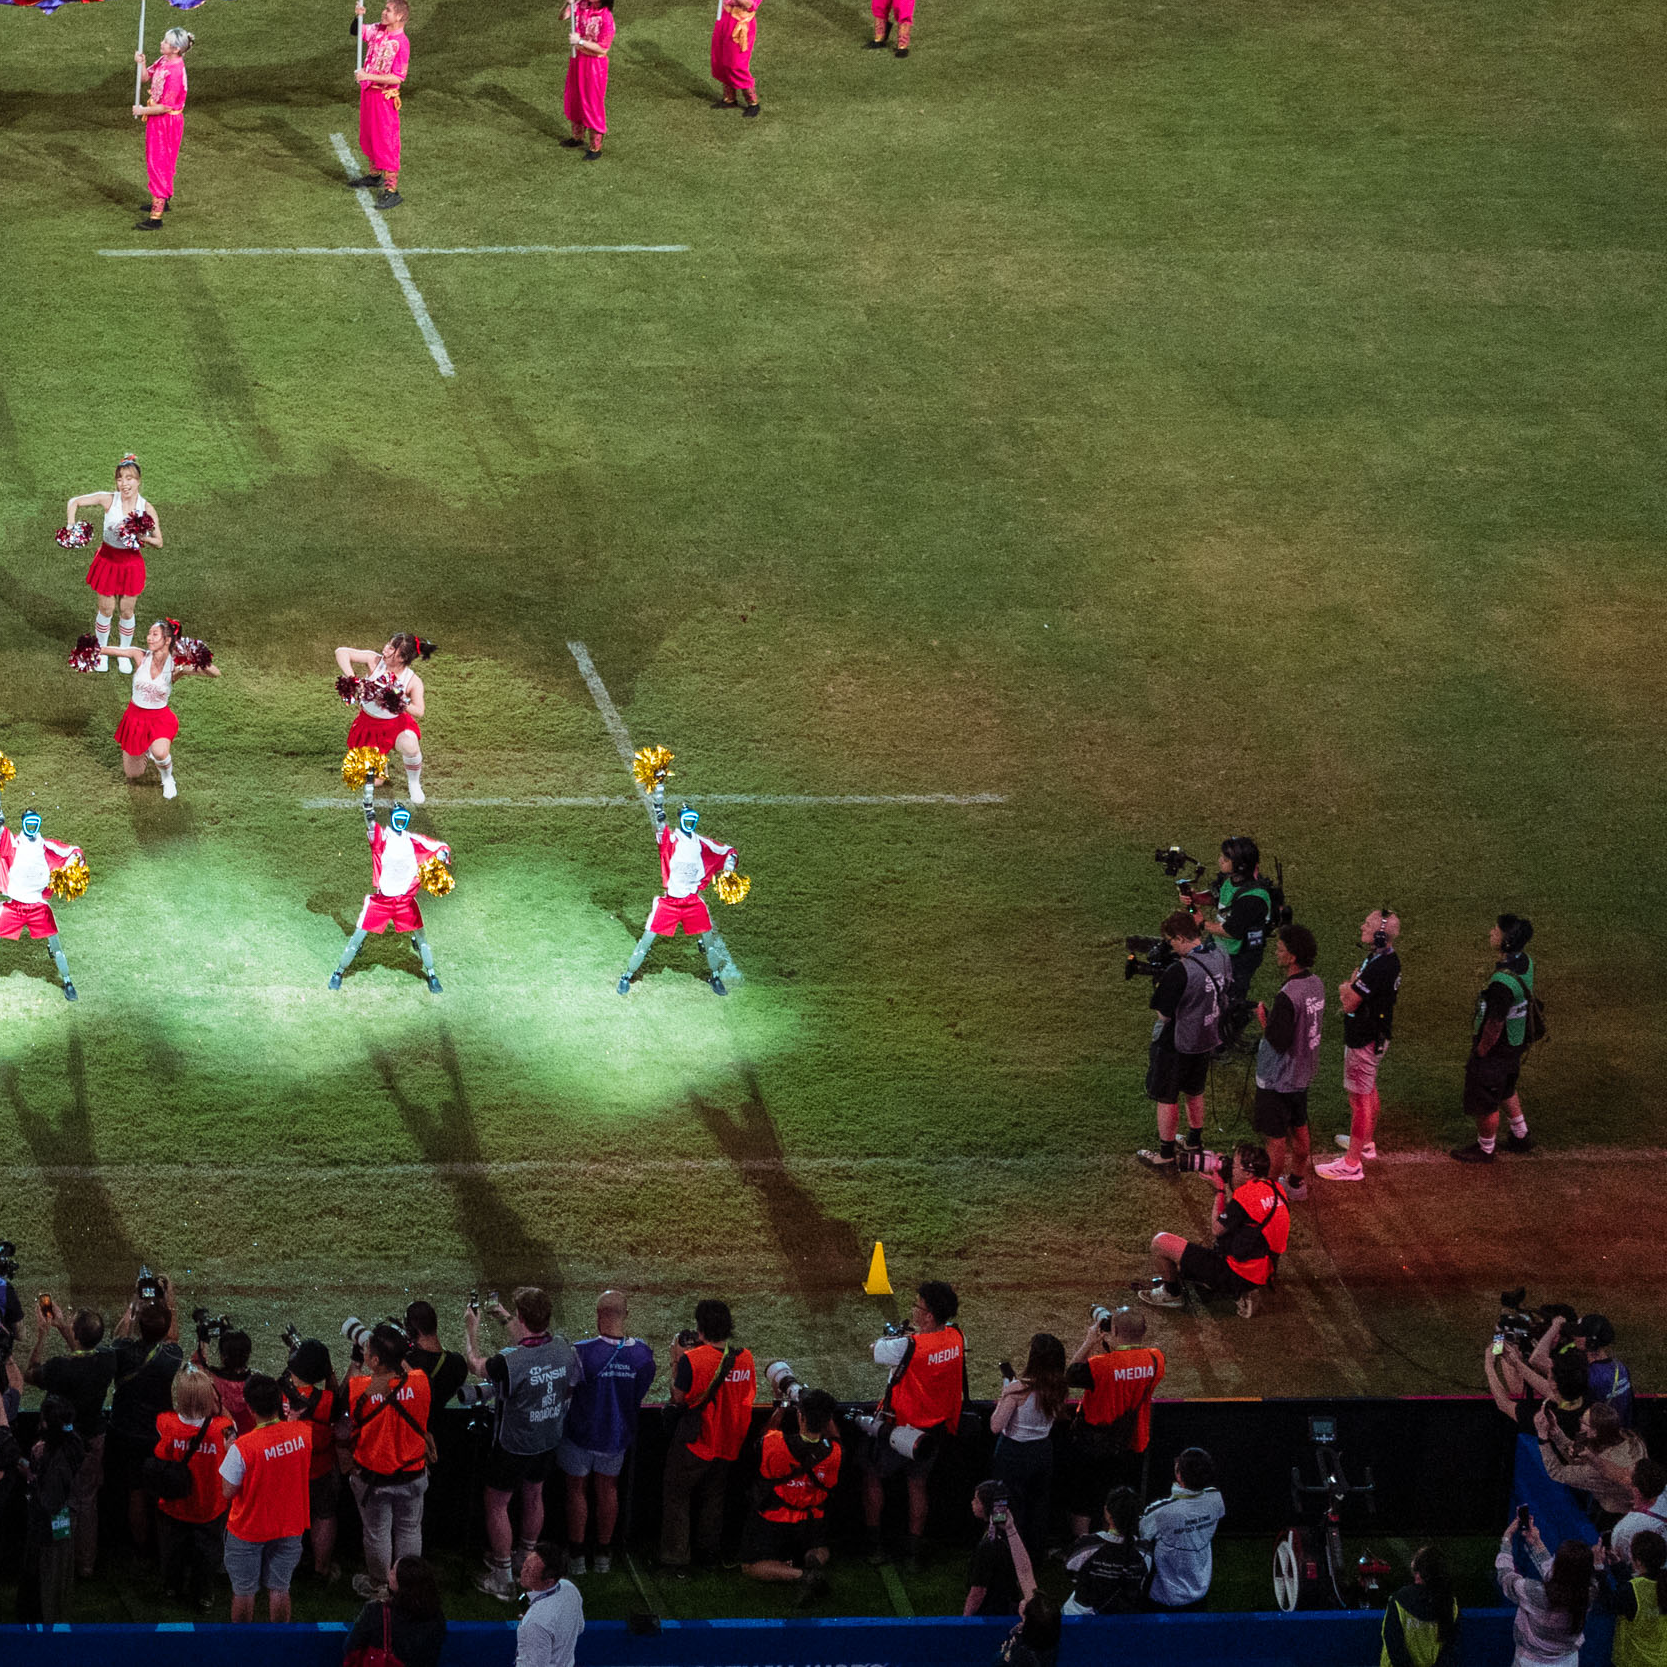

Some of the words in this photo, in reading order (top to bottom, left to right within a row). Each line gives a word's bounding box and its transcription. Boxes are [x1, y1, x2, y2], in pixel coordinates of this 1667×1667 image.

[927, 1345, 960, 1366] MEDIA
[724, 1369, 751, 1383] EDIA
[1114, 1365, 1155, 1382] MEDIA
[264, 1435, 306, 1461] MEDIA
